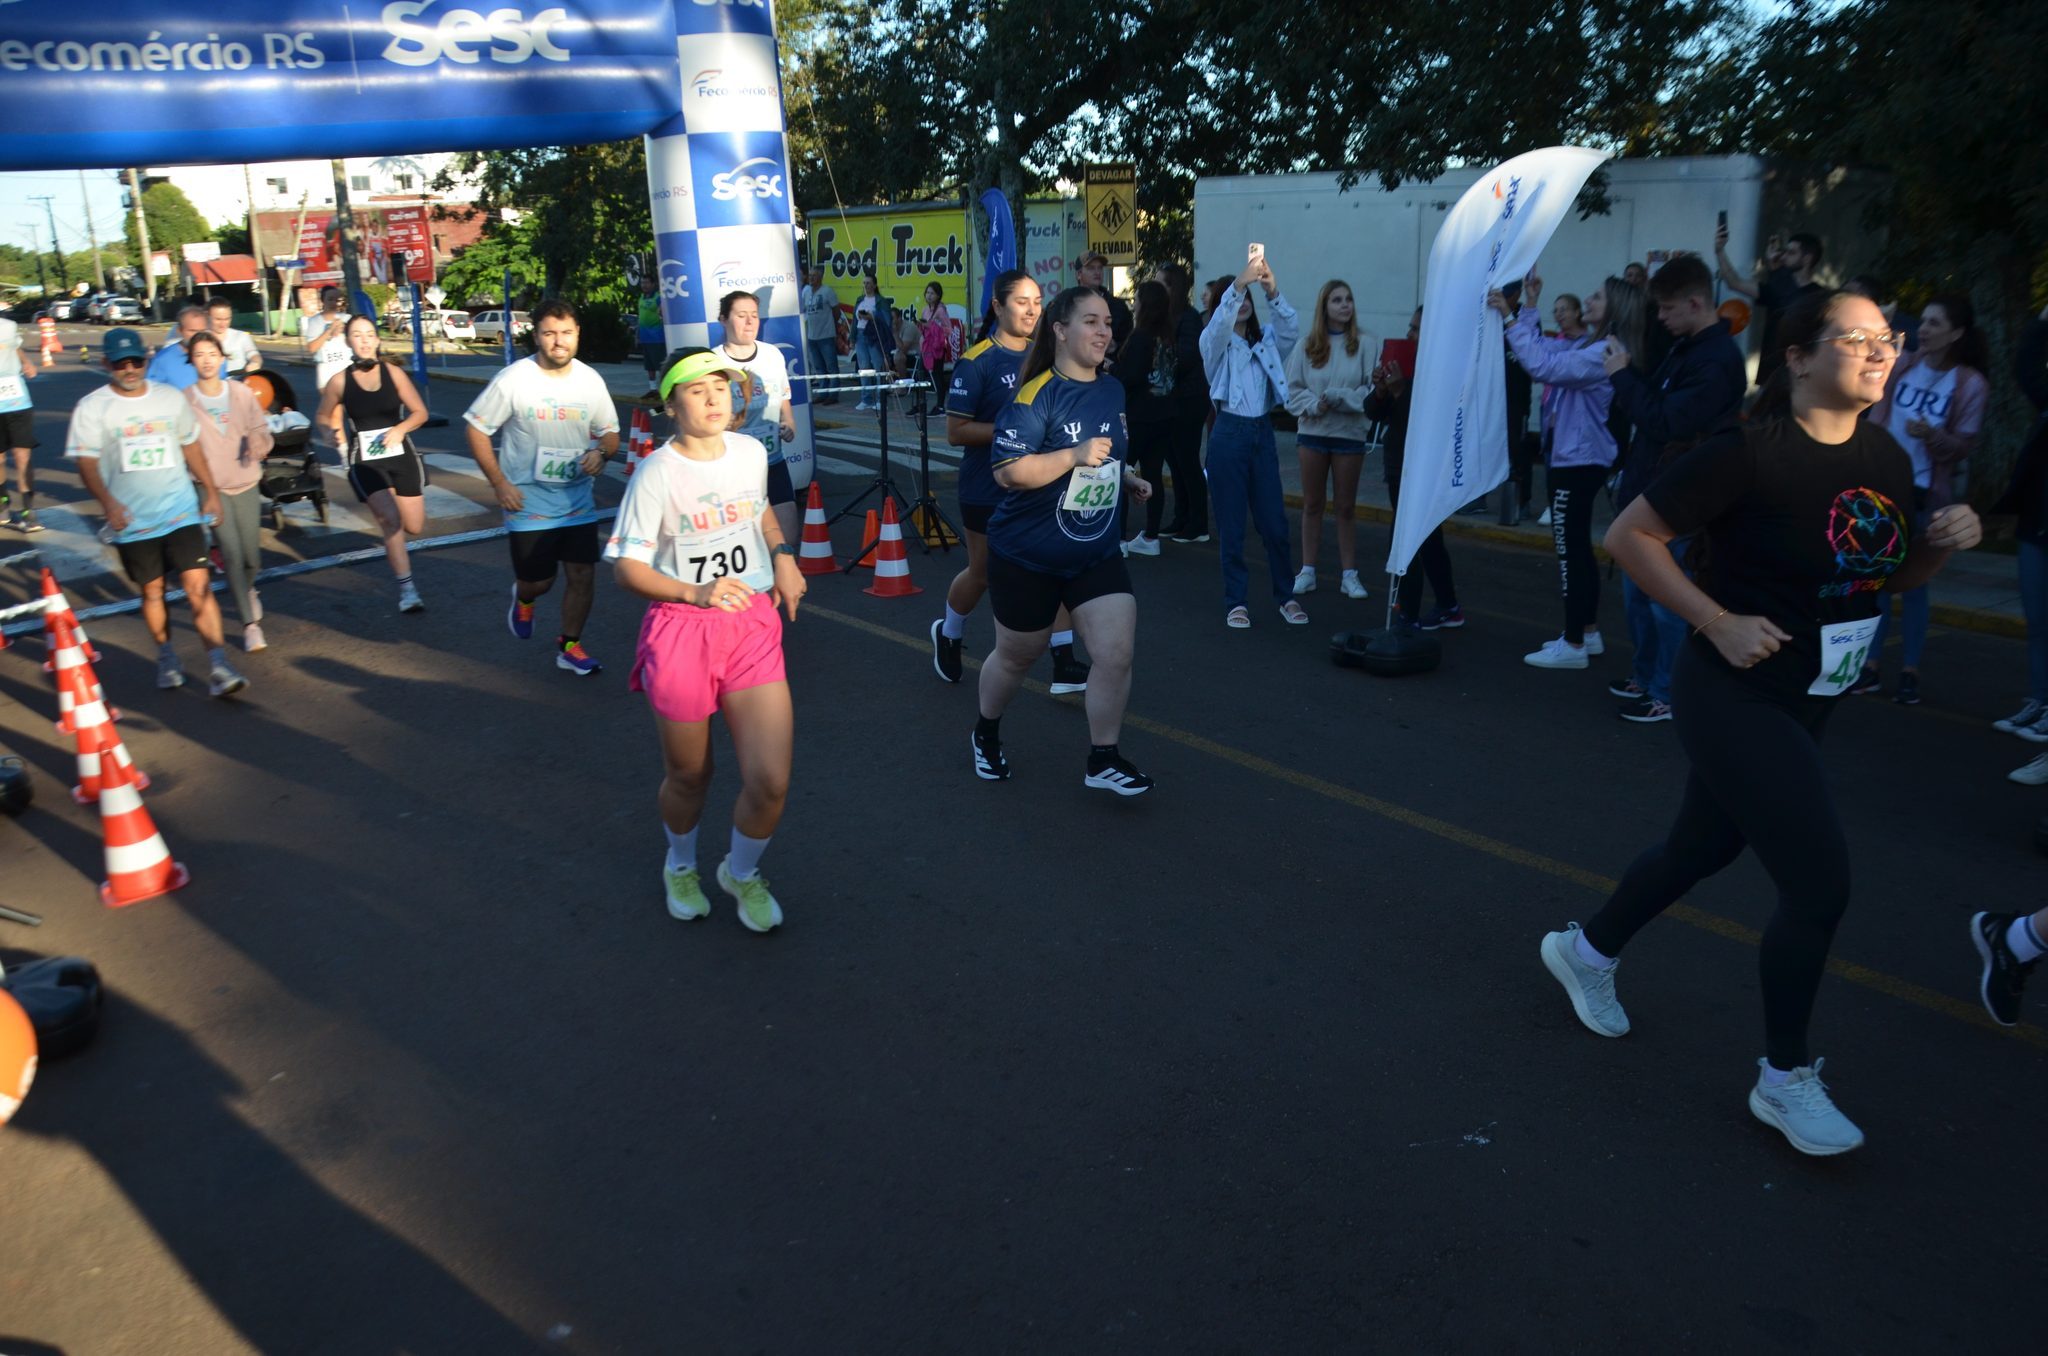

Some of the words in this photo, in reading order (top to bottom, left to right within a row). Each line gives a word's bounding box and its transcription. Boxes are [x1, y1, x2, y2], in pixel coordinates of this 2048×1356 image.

[381, 0, 570, 67] Sesc
[1, 31, 252, 71] ecomércio
[263, 32, 325, 70] RS
[698, 86, 767, 98] Fecoércio
[1089, 168, 1132, 180] DEVAGAR
[673, 186, 688, 197] RS
[816, 227, 878, 278] Food
[891, 224, 963, 276] Truck
[1092, 240, 1134, 254] ELEVADA
[129, 448, 165, 466] 437
[542, 460, 577, 480] 443
[1073, 481, 1115, 508] 432
[1553, 489, 1570, 555] GROWTH
[688, 544, 747, 583] 730
[1826, 646, 1866, 689] 43
